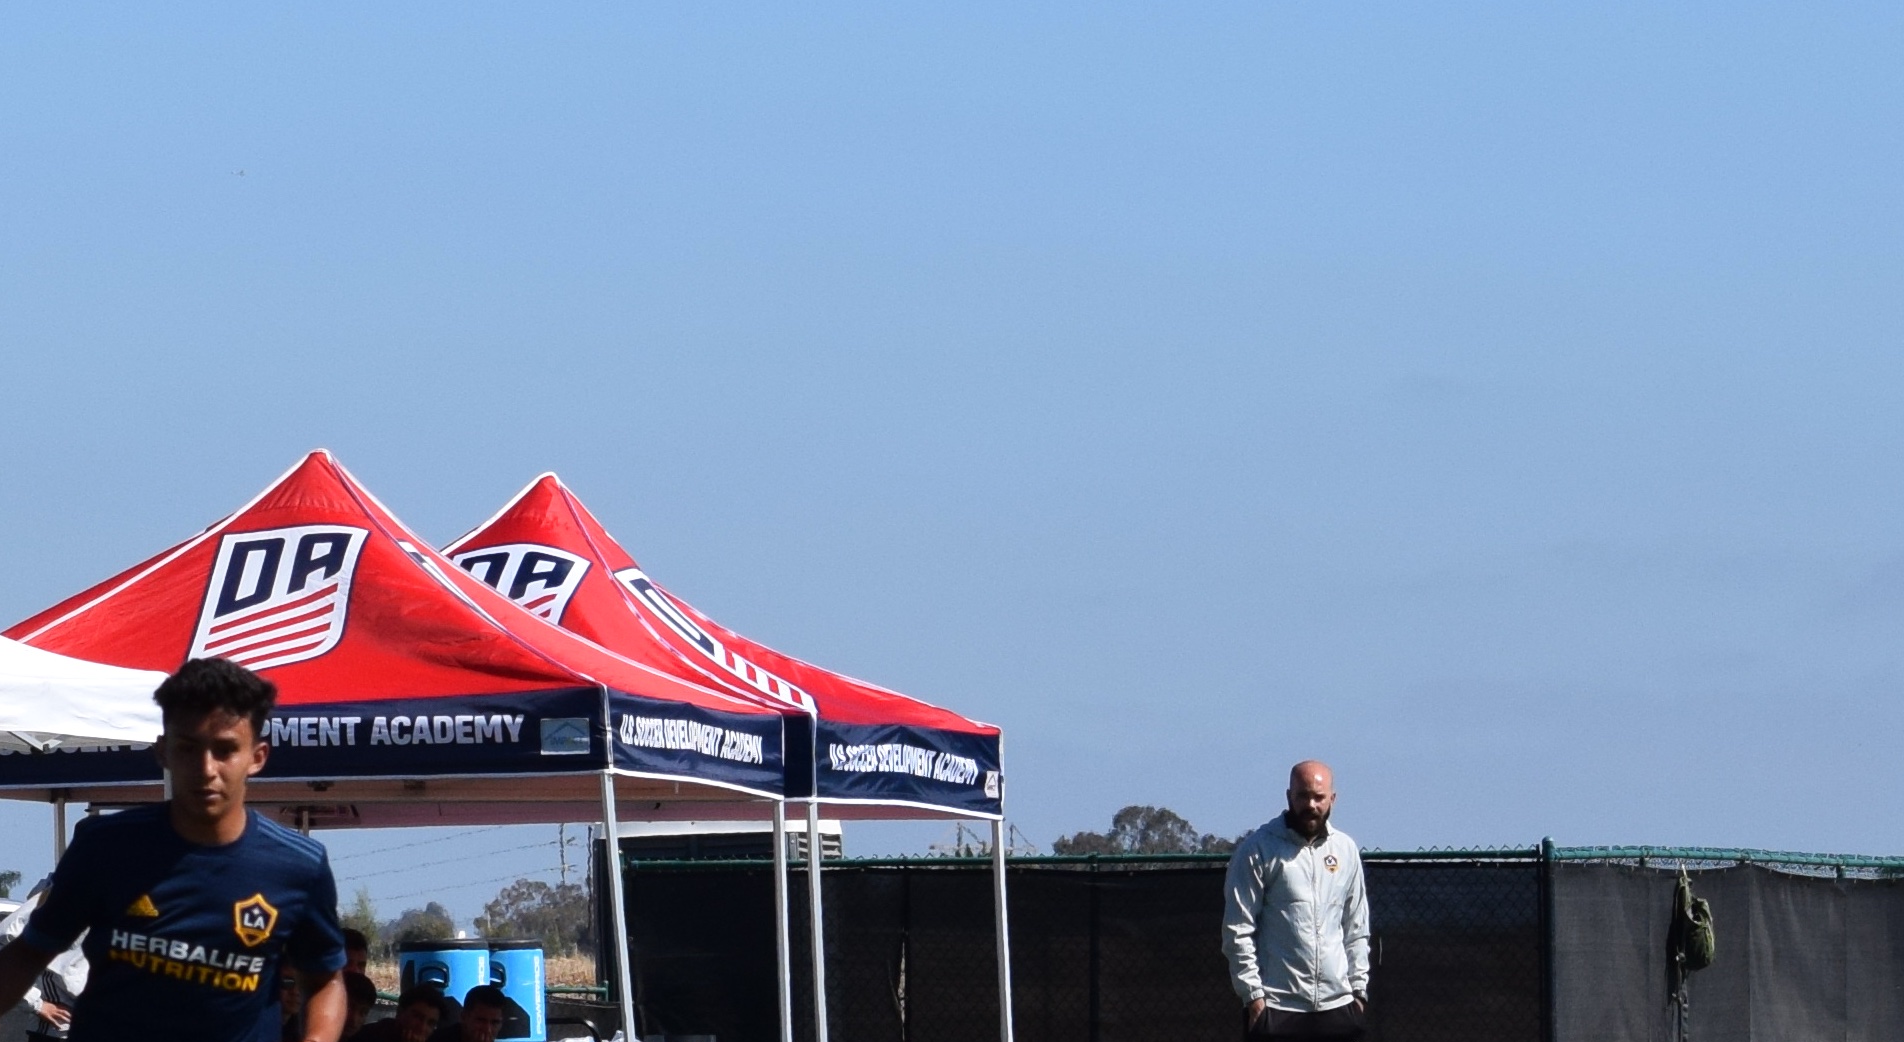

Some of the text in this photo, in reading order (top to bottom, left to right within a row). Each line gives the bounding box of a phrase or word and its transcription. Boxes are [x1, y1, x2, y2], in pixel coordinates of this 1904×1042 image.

[369, 714, 525, 746] ACADEMY
[634, 716, 665, 749] SOCCER
[663, 718, 724, 757] DEVELOPMENT
[719, 729, 764, 765] ACADEMY
[843, 744, 879, 773] SOCCER
[877, 743, 937, 778] DEVELOPMENT
[932, 752, 979, 786] ACADEMY
[242, 912, 266, 930] LA
[108, 948, 260, 992] NUTRITION
[110, 929, 266, 974] HERBALIFE
